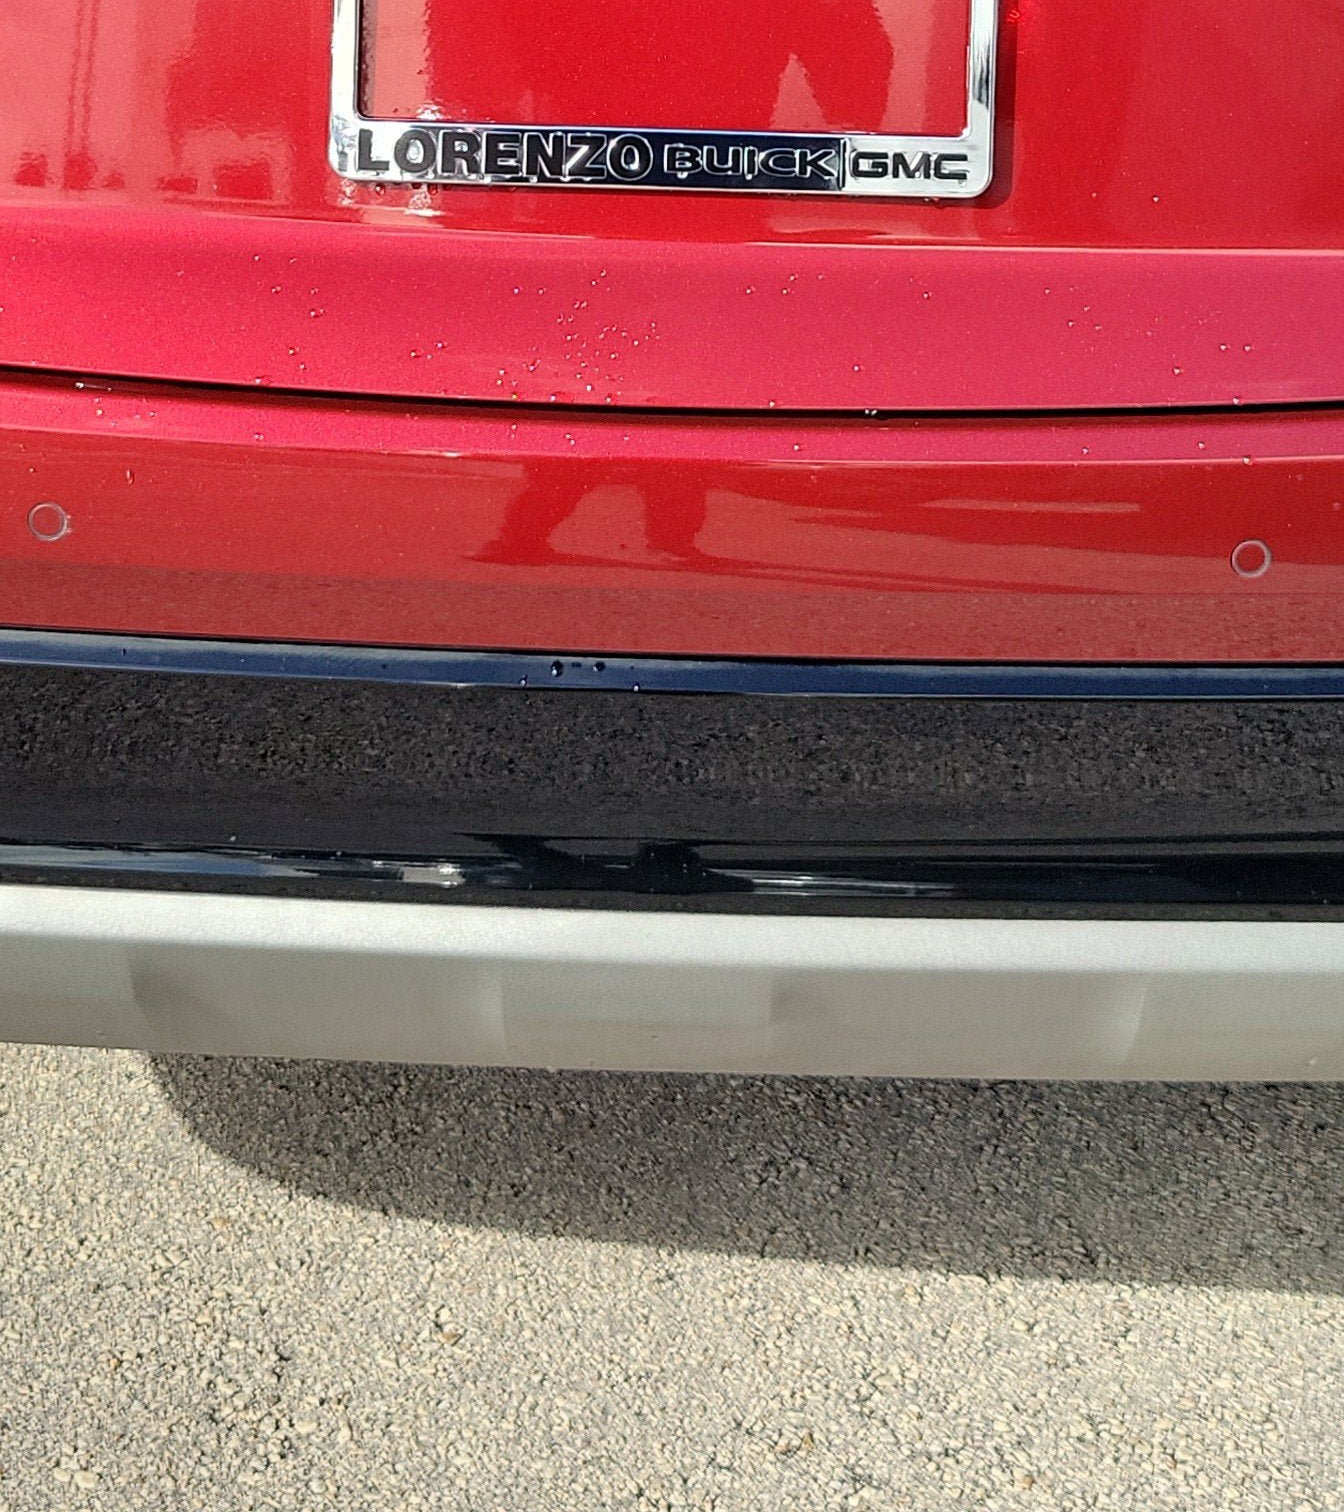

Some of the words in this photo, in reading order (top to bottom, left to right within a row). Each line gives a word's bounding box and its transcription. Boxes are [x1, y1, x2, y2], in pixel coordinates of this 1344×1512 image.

[356, 128, 652, 181] LORENZO
[663, 143, 839, 180] BUICK
[849, 148, 970, 182] GMC
